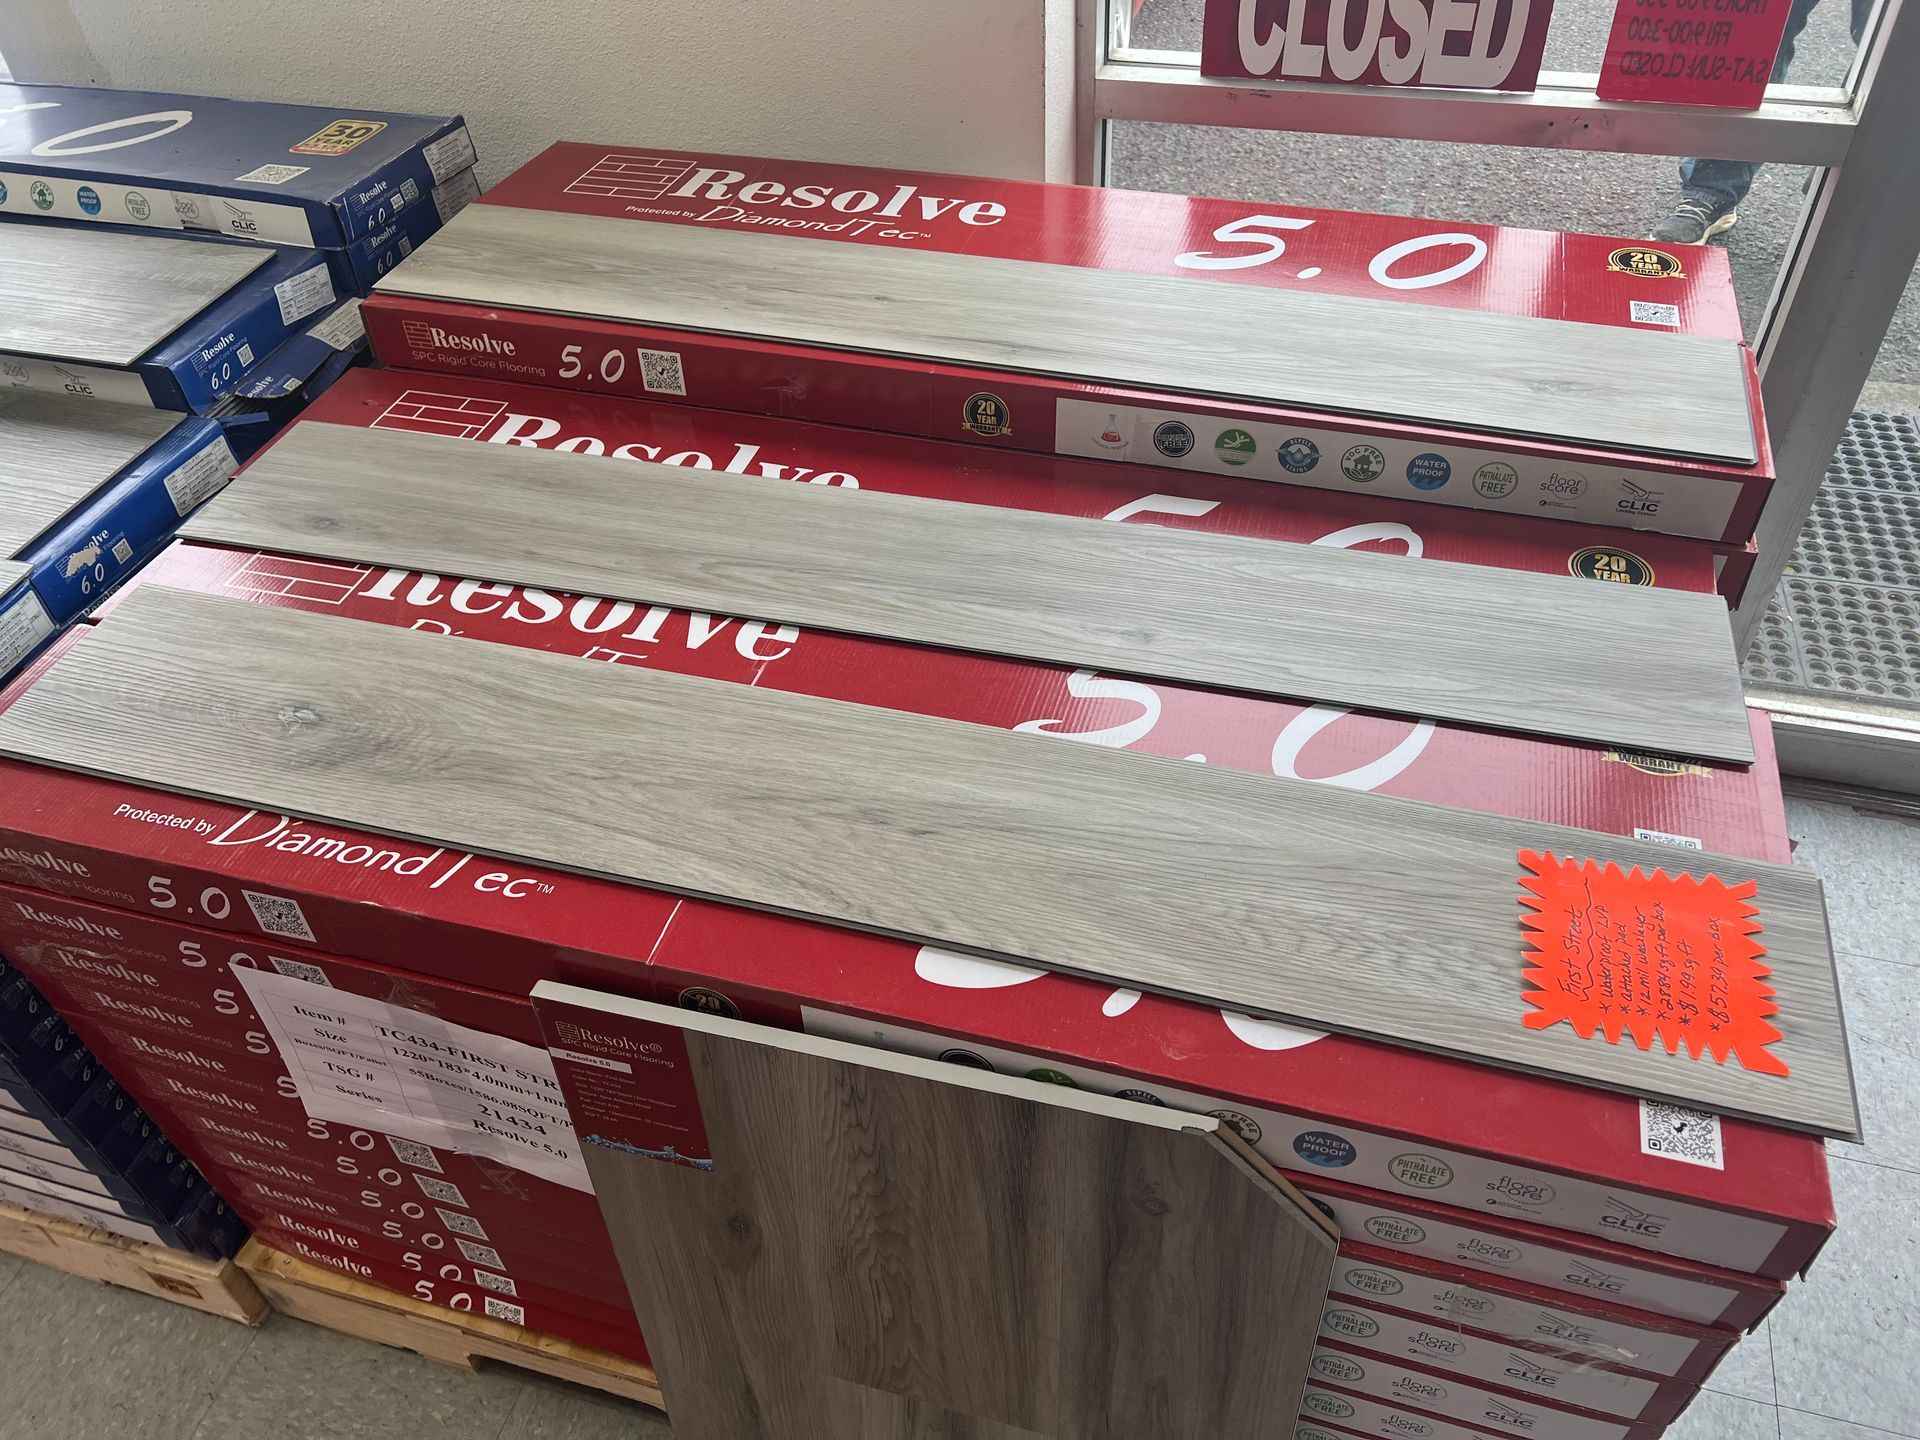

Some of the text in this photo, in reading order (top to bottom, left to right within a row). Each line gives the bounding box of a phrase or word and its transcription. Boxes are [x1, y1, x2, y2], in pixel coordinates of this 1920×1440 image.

[1238, 0, 1531, 89] CLOSED
[324, 125, 374, 139] 30
[314, 138, 354, 146] YEAR
[359, 180, 388, 205] Resolve
[669, 167, 1007, 227] Resolve
[132, 207, 146, 216] FREE
[625, 205, 681, 217] Protected
[682, 211, 697, 220] by
[231, 219, 257, 231] CLIC
[371, 223, 398, 248] Resolve
[1174, 214, 1489, 289] 5.0
[1629, 252, 1658, 264] 20
[1619, 266, 1672, 276] WARRANTY
[1629, 261, 1661, 271] YEAR
[201, 332, 236, 363] Resolve
[431, 327, 517, 357] Resolve
[411, 350, 546, 377] SPC Rigid Core Flooring
[558, 344, 626, 384] 5.0
[211, 362, 231, 390] 6.0
[64, 383, 93, 395] CLIC
[977, 399, 996, 415] 20
[969, 423, 1004, 434] WARRANTY
[976, 414, 998, 425] YEAR
[1161, 440, 1188, 448] FREE
[1345, 447, 1382, 466] VOC FREE
[1414, 458, 1448, 470] WATER
[1285, 464, 1308, 474] STAINS
[1412, 467, 1445, 478] PROOF
[1478, 470, 1515, 484] PHTHALATE
[1480, 481, 1507, 494] FREE
[1540, 483, 1579, 495] score
[1550, 472, 1582, 487] floor
[1617, 499, 1660, 512] CLIC
[1594, 553, 1627, 572] 20
[81, 563, 105, 594] 6.0
[1593, 569, 1631, 583] YEAR
[1617, 752, 1691, 773] WARRANTY
[113, 803, 192, 832] Protected
[193, 819, 218, 837] by
[0, 847, 91, 879] esolve
[148, 875, 231, 920] 5.0
[15, 902, 123, 940] Resolve
[1651, 901, 1664, 922] box
[1613, 922, 1635, 947] pad
[1557, 904, 1583, 997] First Street
[1713, 943, 1730, 967] per
[54, 949, 160, 988] Resolve
[1676, 971, 1700, 1016] $1.99
[94, 991, 194, 1028] Resolve
[293, 1005, 347, 1026] Item #
[313, 1027, 348, 1044] Size
[130, 1036, 227, 1073] Resolve
[375, 1025, 509, 1073] TC434-FIRST
[560, 1037, 675, 1069] SPC Rigid Core Flooring
[565, 1052, 598, 1065] Resolve
[323, 1061, 375, 1082] TSG #
[166, 1077, 259, 1115] Resolve
[336, 1084, 383, 1104] Series
[476, 1103, 548, 1136] 21434
[1231, 1113, 1258, 1134] FREE
[199, 1116, 290, 1151] Resolve
[306, 1117, 375, 1151] 5.0
[471, 1118, 569, 1160] Resolve 5.0
[1304, 1133, 1350, 1150] WATER
[1302, 1142, 1348, 1158] PROOF
[228, 1151, 316, 1186] Resolve
[336, 1155, 403, 1187] 5.0
[1397, 1158, 1448, 1178] PHTHALATE
[1400, 1169, 1437, 1186] FREE
[1486, 1181, 1543, 1201] score
[1499, 1175, 1547, 1194] floor
[254, 1183, 339, 1215] Resolve
[360, 1189, 426, 1220] 5.0
[278, 1213, 360, 1250] Resolve
[1372, 1219, 1420, 1237] PHTHALATE
[1601, 1214, 1663, 1235] CLIC
[382, 1220, 445, 1251] 5.0
[1376, 1229, 1412, 1242] FREE
[1456, 1242, 1511, 1260] score
[1468, 1238, 1512, 1255] floor
[294, 1240, 373, 1279] Resolve
[1353, 1271, 1398, 1289] PHTHALATE
[1355, 1279, 1389, 1293] FREE
[1565, 1273, 1623, 1292] CLIC
[1331, 1313, 1374, 1330] PHTHALATE
[1334, 1321, 1366, 1336] FREE
[1407, 1336, 1456, 1353] score
[1418, 1331, 1460, 1348] floor
[1319, 1358, 1360, 1374] PHTHALATE
[1321, 1366, 1353, 1379] FREE
[1401, 1376, 1441, 1392] floor
[1505, 1367, 1559, 1385] CLIC
[1313, 1403, 1343, 1417] FREE
[1484, 1411, 1534, 1429] CLIC
